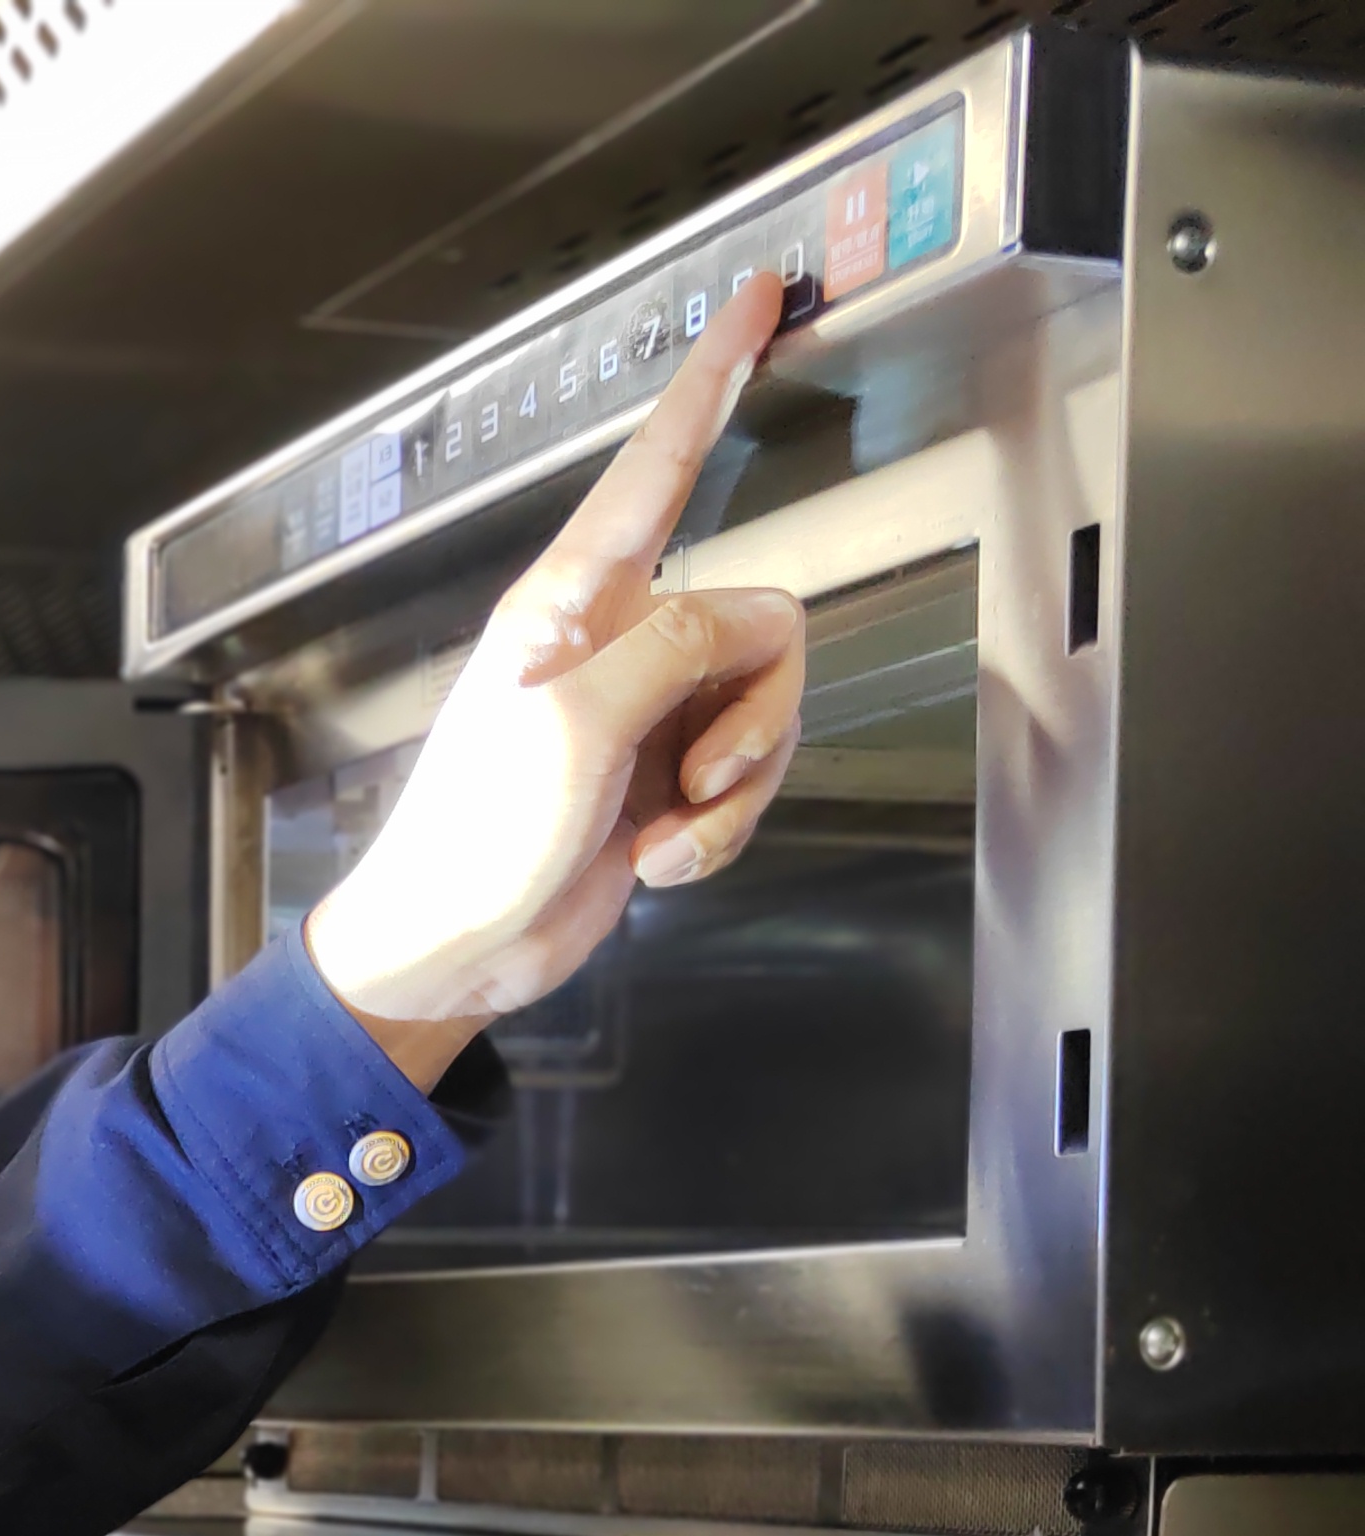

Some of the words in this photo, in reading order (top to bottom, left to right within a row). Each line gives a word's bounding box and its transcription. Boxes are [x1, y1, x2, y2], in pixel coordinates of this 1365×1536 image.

[414, 440, 429, 477] 1
[446, 421, 462, 463] 2
[481, 401, 498, 443] 3
[519, 381, 537, 418] 4
[559, 359, 577, 403] 5
[599, 338, 618, 382] 6
[642, 315, 662, 360] 7
[686, 292, 707, 338] 8
[780, 241, 804, 288] 0
